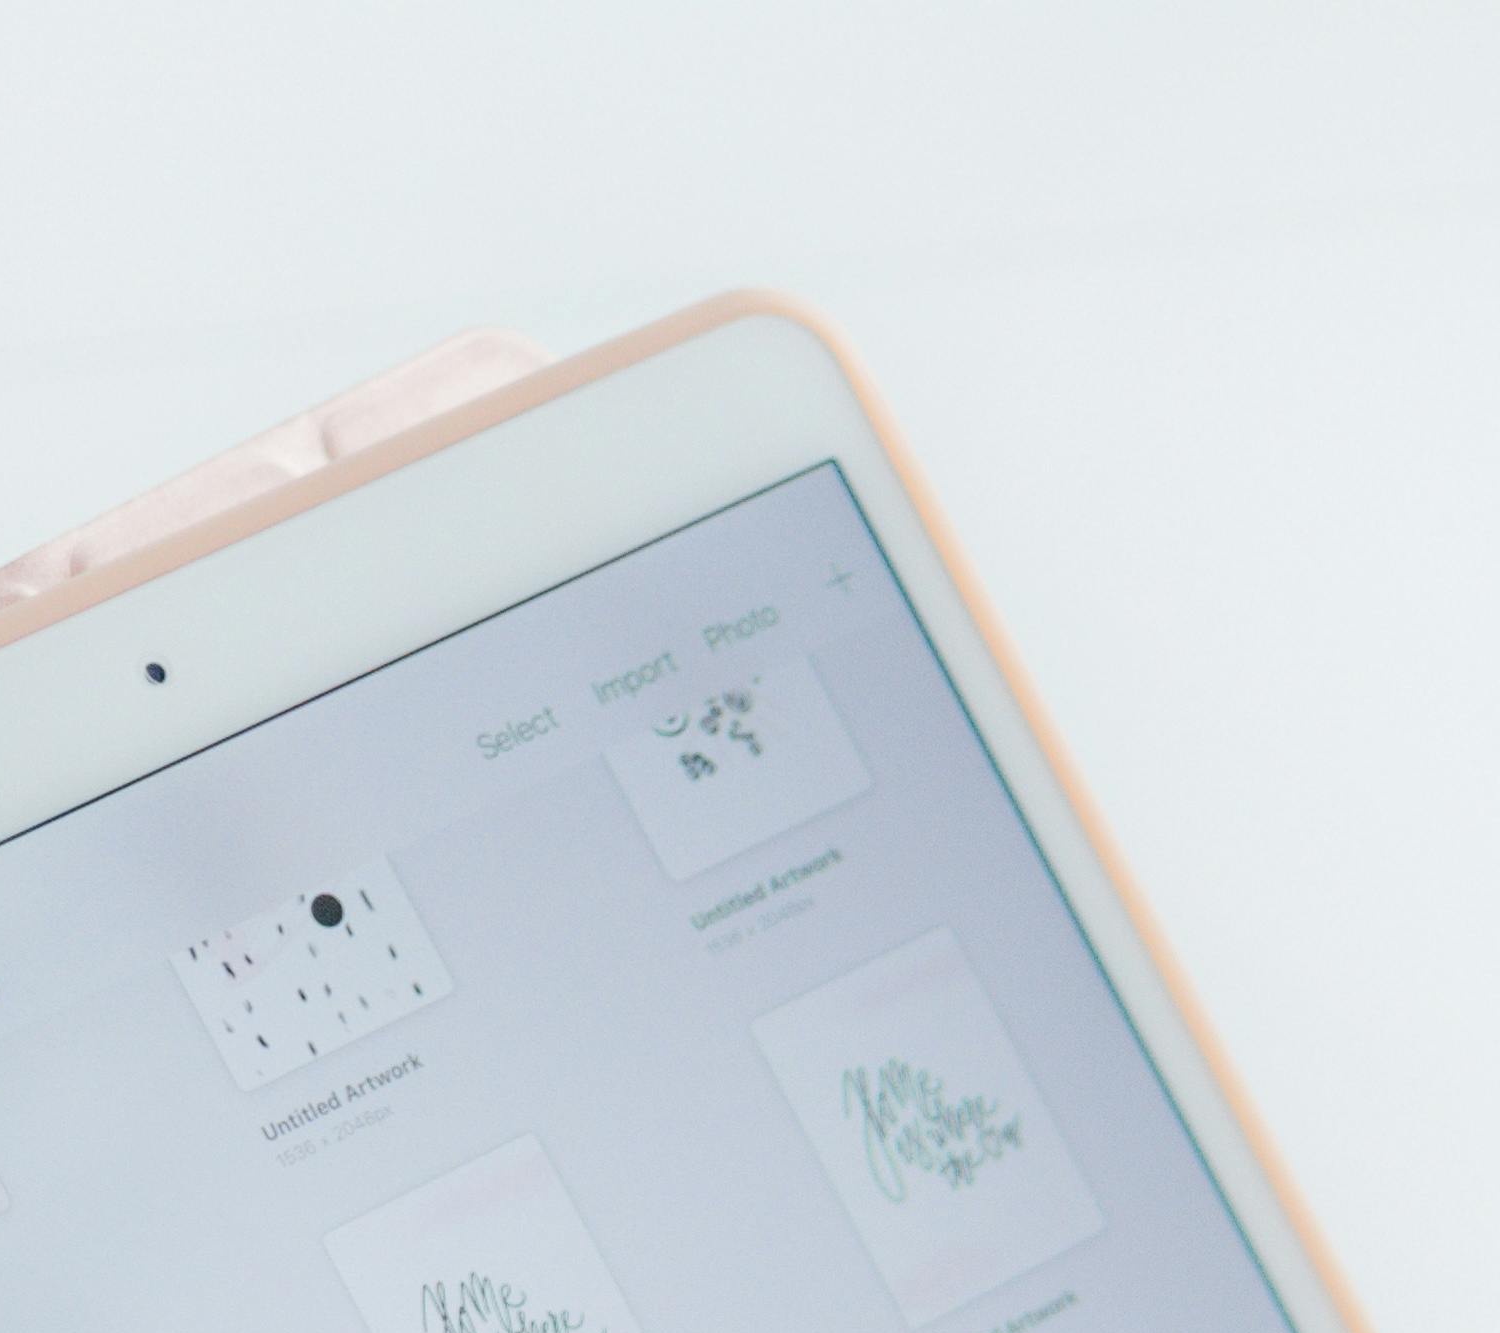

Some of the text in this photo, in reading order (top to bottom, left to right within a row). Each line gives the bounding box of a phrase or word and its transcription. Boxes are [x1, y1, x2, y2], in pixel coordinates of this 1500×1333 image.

[476, 605, 780, 760] Select Import Photo
[261, 1054, 423, 1142] Untitled Artwork
